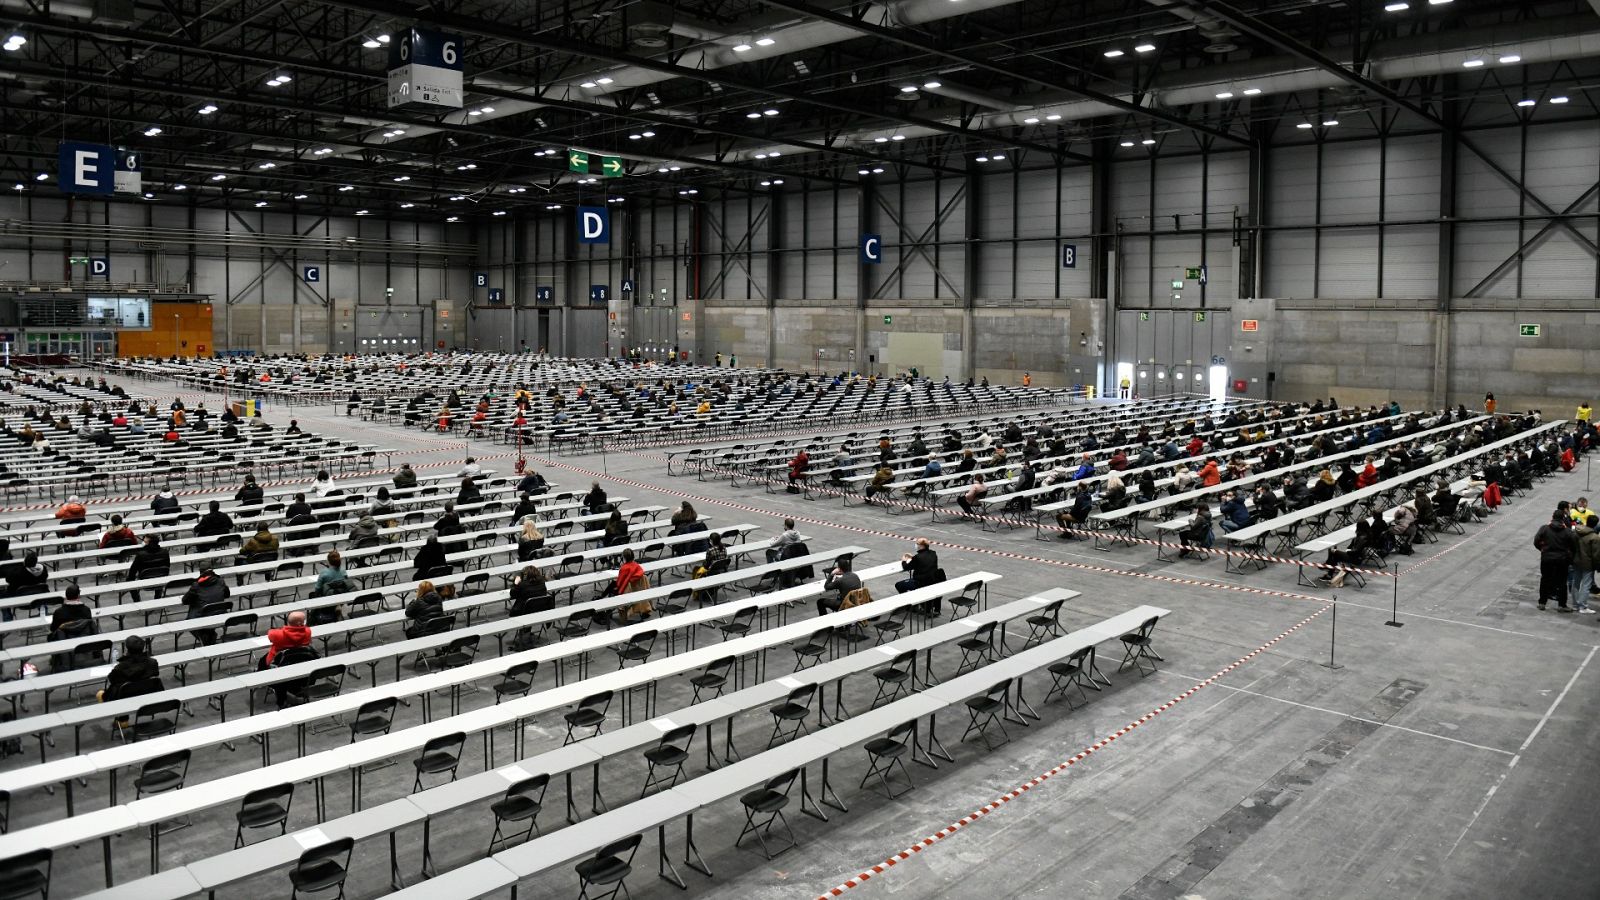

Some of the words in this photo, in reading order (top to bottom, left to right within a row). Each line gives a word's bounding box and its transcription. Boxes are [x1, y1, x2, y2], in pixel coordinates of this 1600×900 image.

[400, 37, 409, 60] 6
[442, 41, 457, 65] 6
[75, 150, 99, 187] E
[126, 155, 137, 169] 6
[583, 212, 604, 238] D
[865, 238, 878, 259] C
[1066, 247, 1074, 265] B
[93, 260, 106, 273] D
[307, 268, 317, 280] C
[477, 275, 485, 286] B
[1199, 268, 1206, 282] A
[622, 281, 632, 291] A
[544, 290, 550, 299] 8
[600, 289, 605, 299] 8
[1212, 355, 1226, 365] 6e
